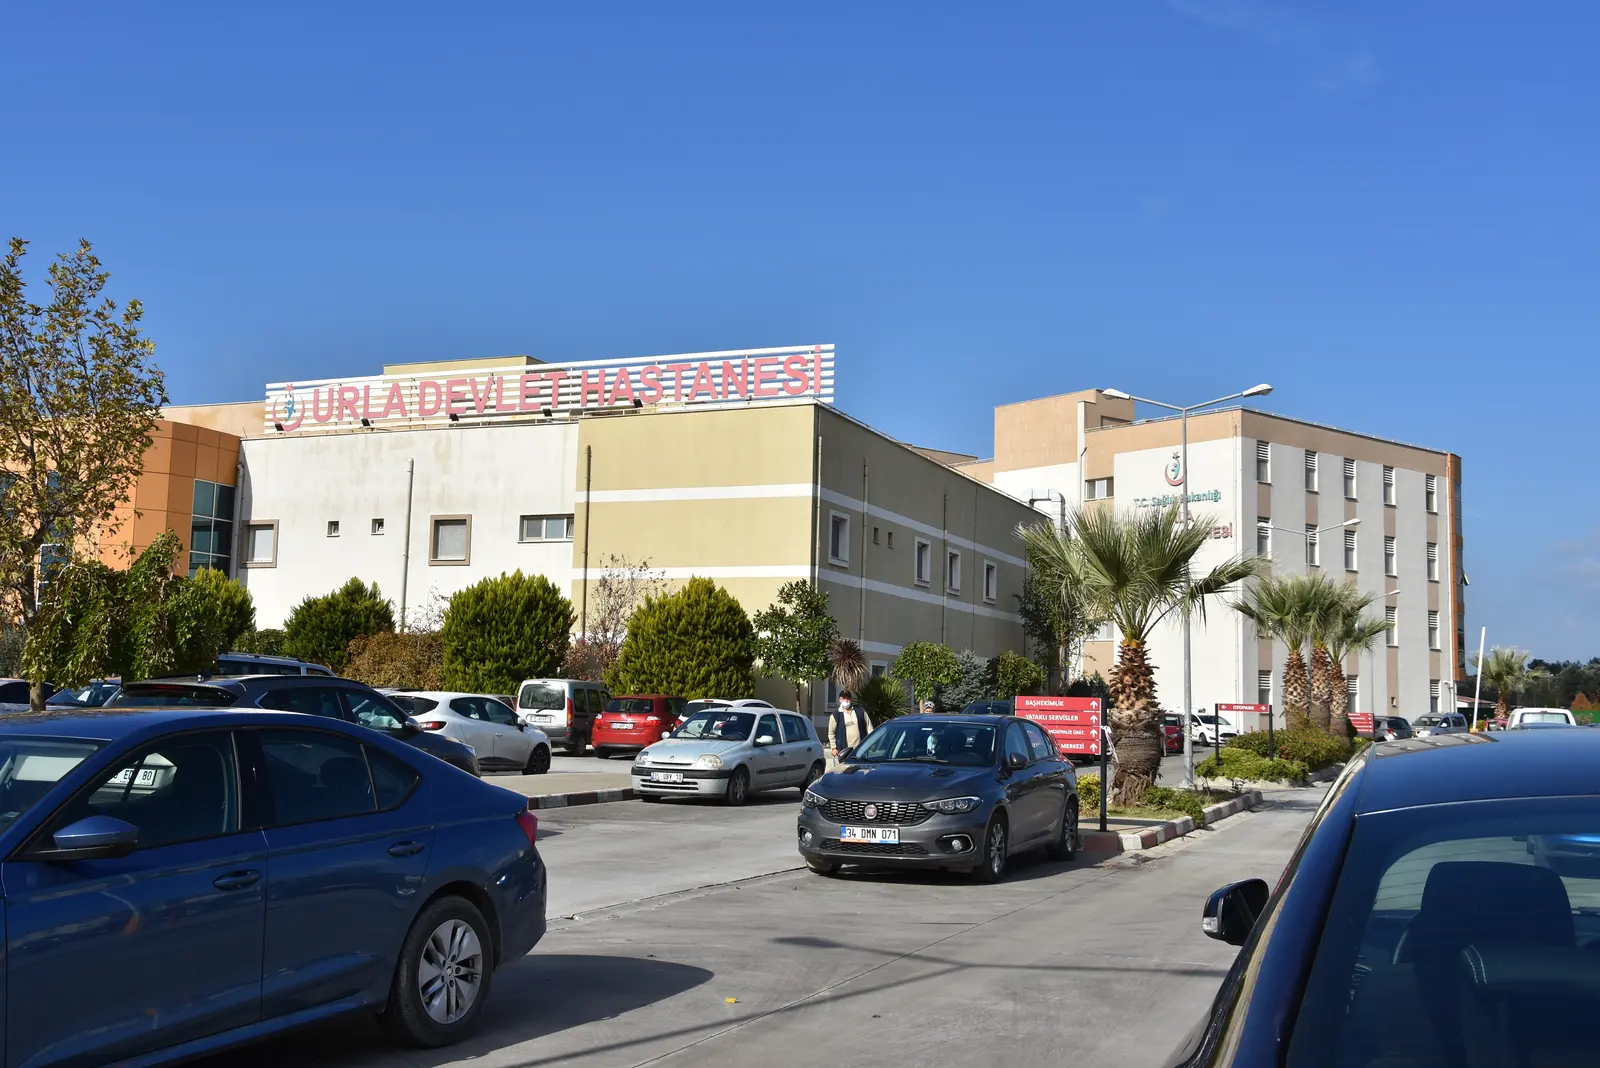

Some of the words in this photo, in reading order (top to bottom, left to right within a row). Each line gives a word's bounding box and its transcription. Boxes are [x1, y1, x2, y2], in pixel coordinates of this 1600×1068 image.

[312, 383, 408, 422] URLA
[418, 371, 568, 417] DEVLET
[580, 346, 821, 407] HASTANESİ
[1025, 699, 1064, 707] BAŞHEKİMLİK
[142, 771, 152, 780] 80
[847, 829, 856, 838] 34
[861, 829, 876, 838] DMN
[882, 830, 896, 839] 071
